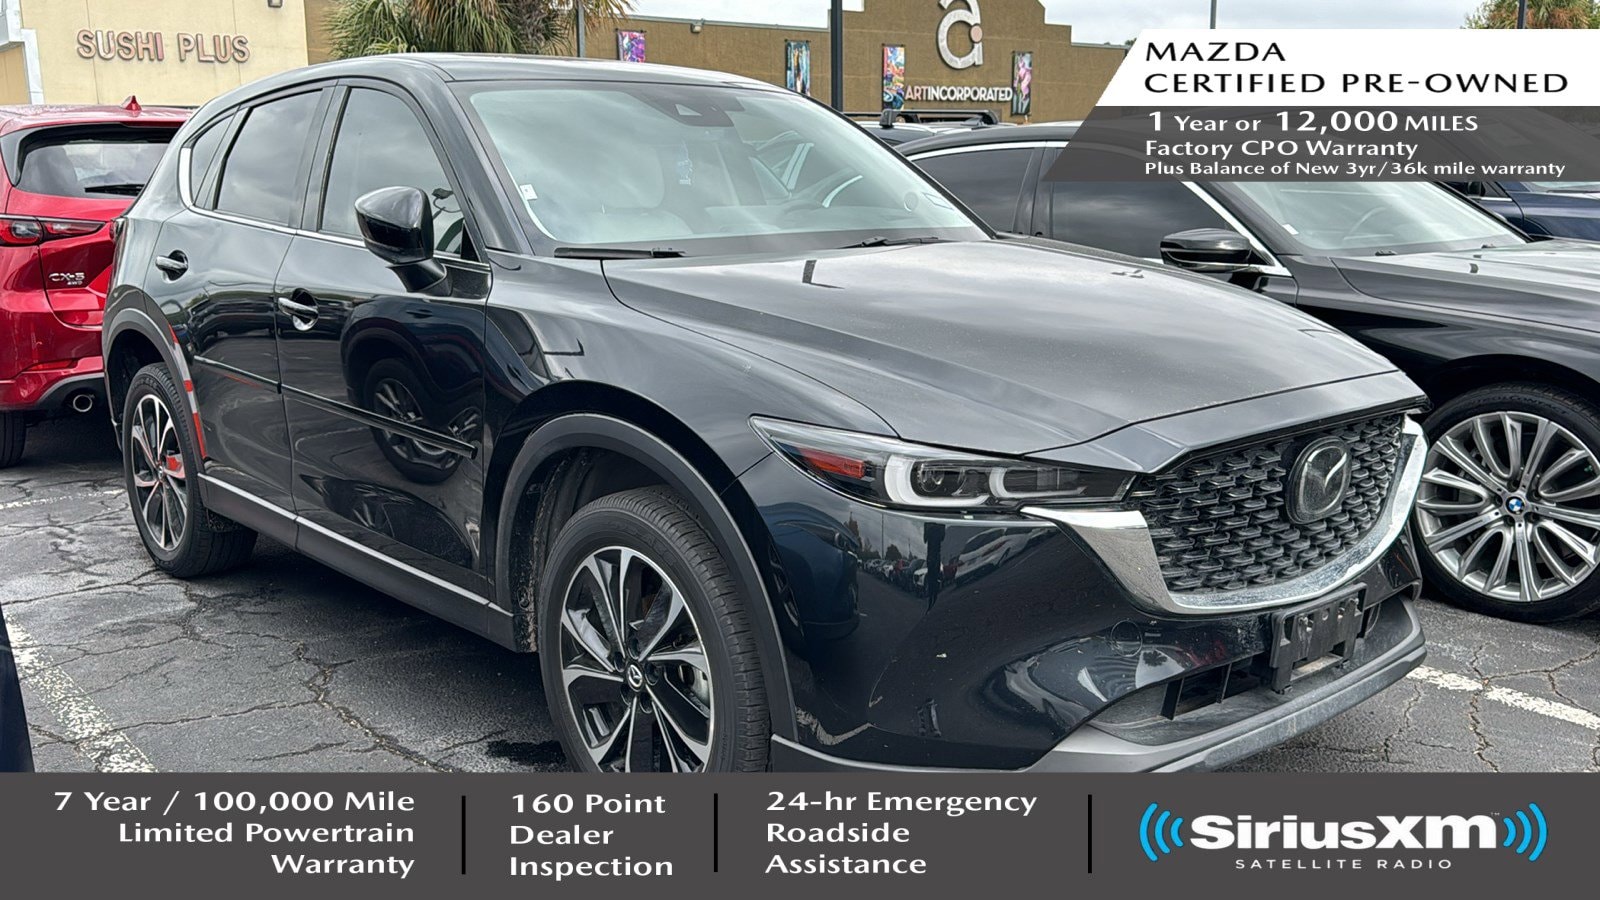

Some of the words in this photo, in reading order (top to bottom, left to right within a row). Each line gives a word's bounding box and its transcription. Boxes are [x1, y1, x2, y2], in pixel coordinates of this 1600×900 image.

[77, 29, 164, 61] SUSHI
[177, 33, 250, 63] PLUS
[49, 272, 85, 282] CX-5
